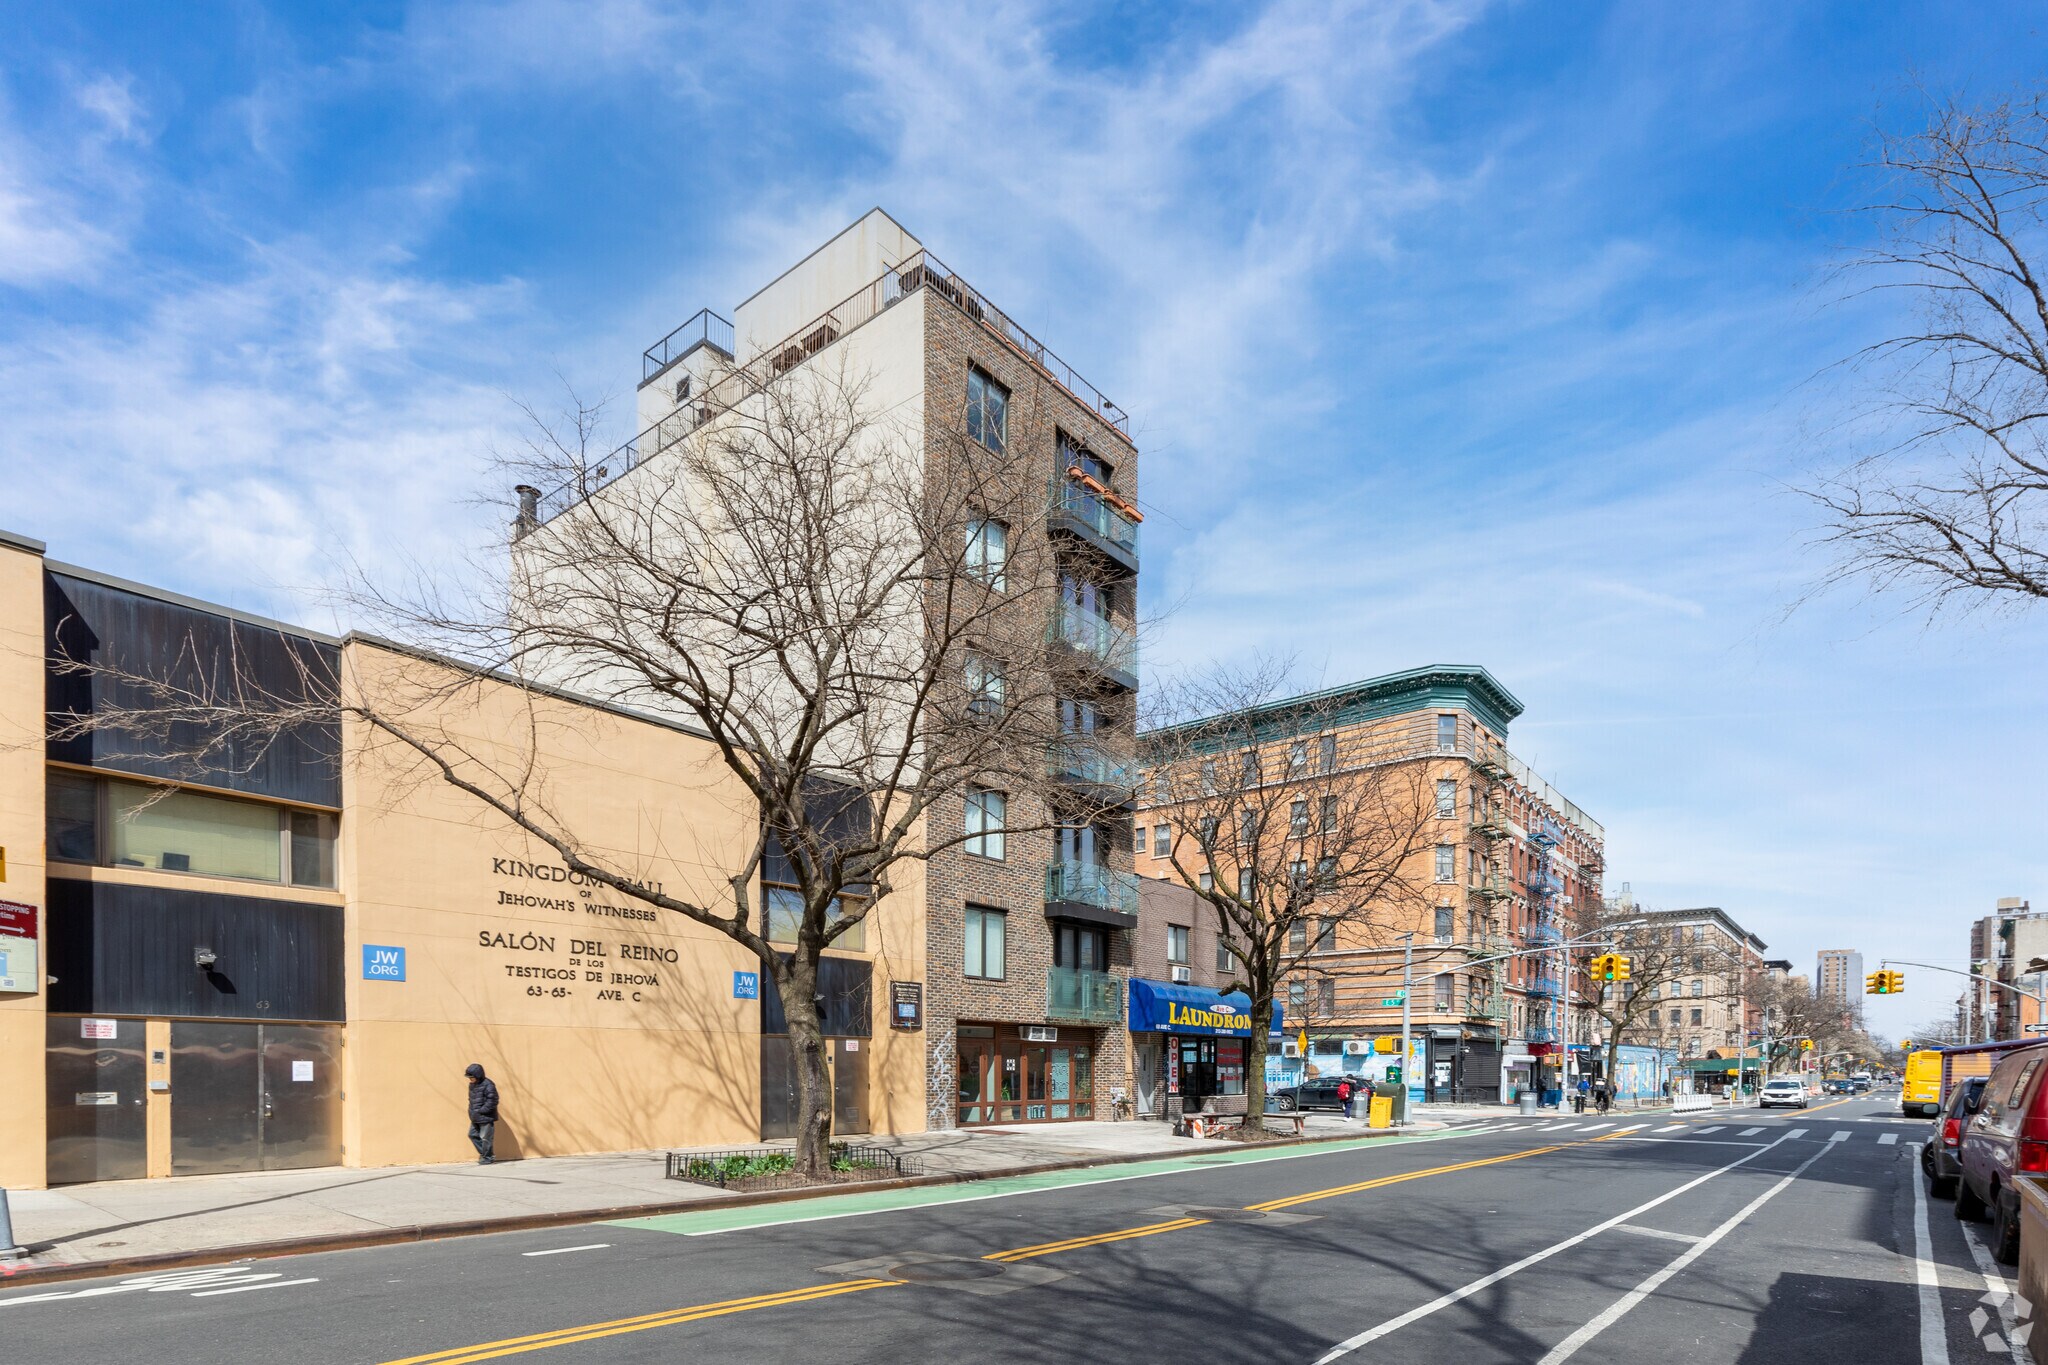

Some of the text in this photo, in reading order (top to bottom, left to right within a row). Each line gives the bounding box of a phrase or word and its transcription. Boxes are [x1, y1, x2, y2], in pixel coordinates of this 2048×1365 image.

[493, 857, 666, 897] KINGDOM ALL
[579, 890, 592, 899] OF
[0, 903, 30, 915] STOPPING
[498, 890, 657, 922] JEHOVAH'S WITNESSES
[479, 930, 679, 964] SALÓN DEL REINO
[371, 950, 399, 964] JW
[569, 958, 604, 968] DE LOS
[368, 964, 400, 976] .ORG
[505, 965, 660, 986] TESTIGOS DE JEHOVÁ
[737, 975, 755, 986] JW
[597, 989, 625, 1002] AVE.
[632, 991, 641, 1002] C
[736, 986, 755, 995] .ORG
[256, 1000, 270, 1009] 63
[1169, 1001, 1252, 1029] LAUNDROM
[1171, 1038, 1179, 1093] OPEN
